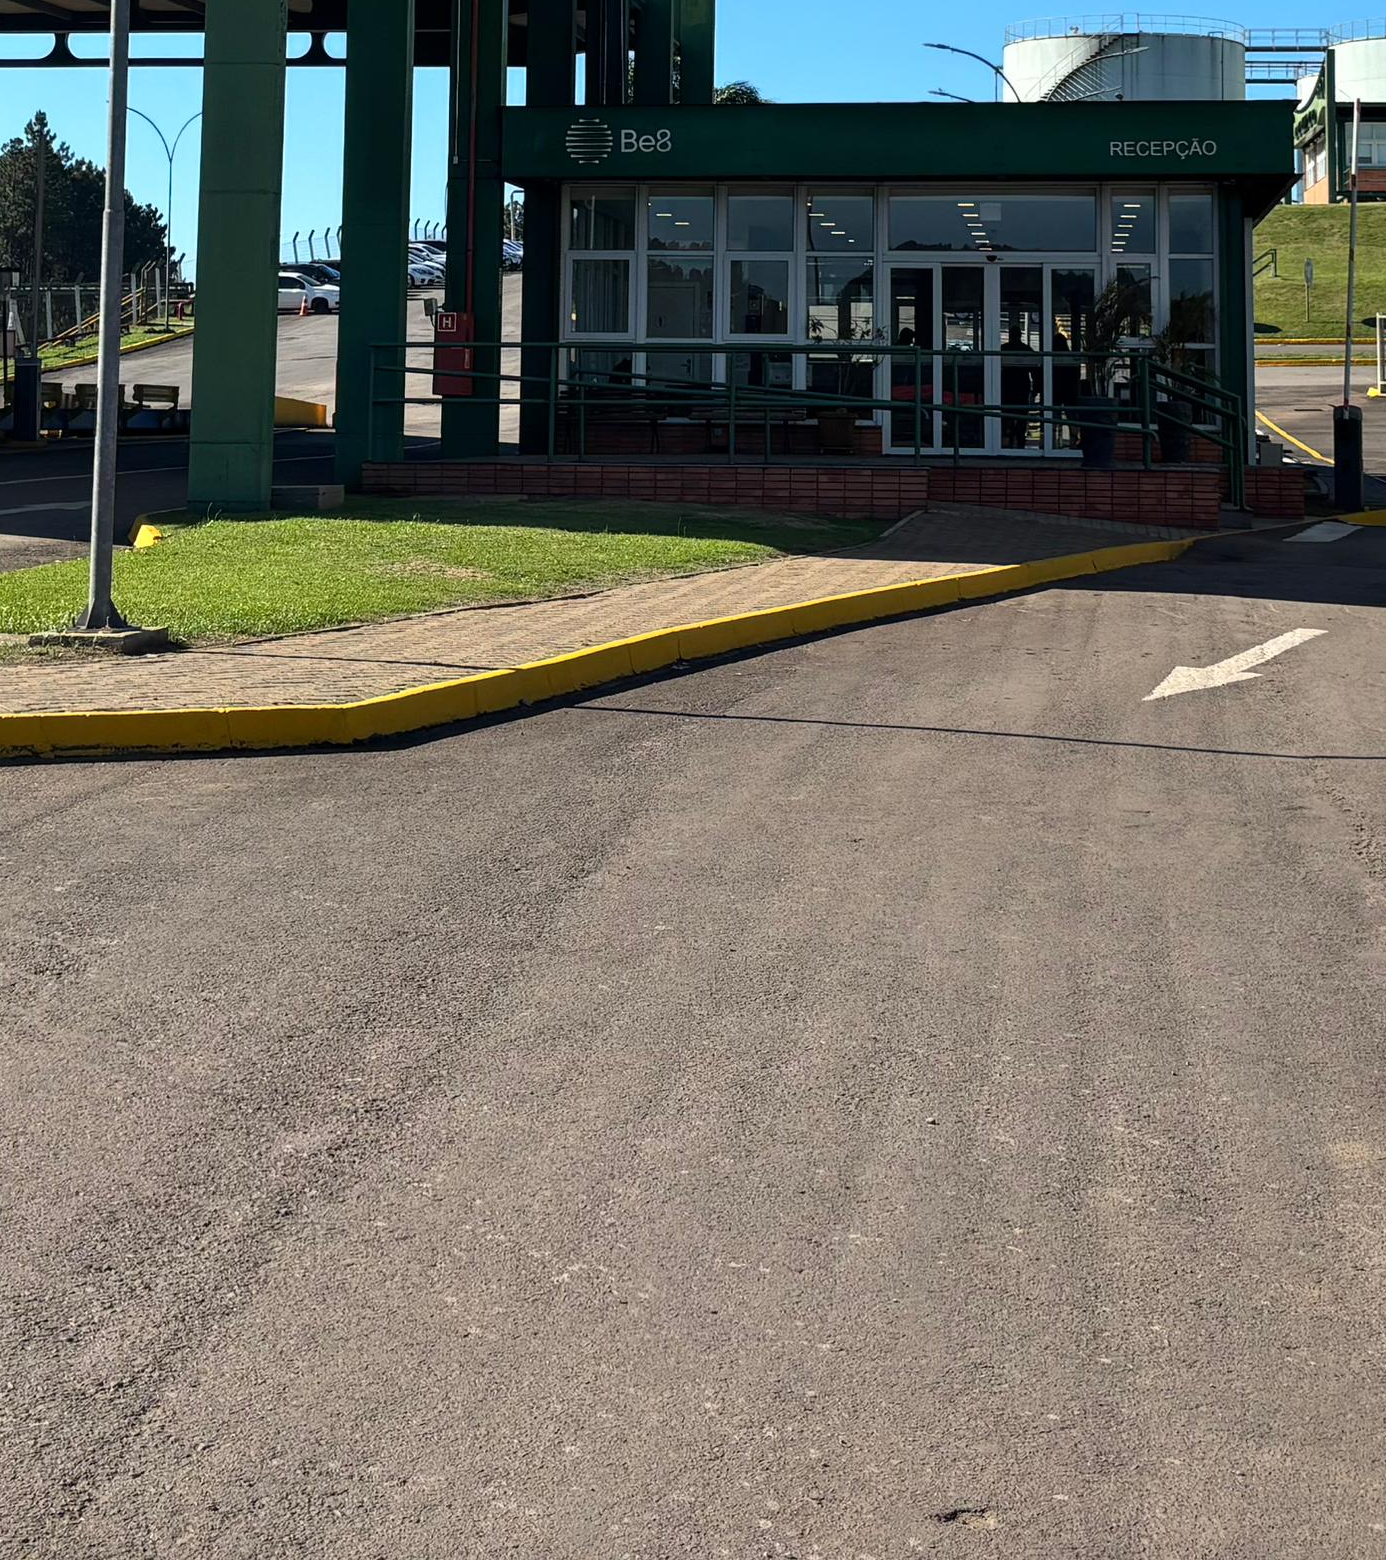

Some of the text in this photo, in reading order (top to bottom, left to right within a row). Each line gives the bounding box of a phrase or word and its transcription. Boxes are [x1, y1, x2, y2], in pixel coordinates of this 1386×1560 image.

[620, 128, 672, 153] Be8
[1109, 138, 1217, 160] RECEPÇÃO
[442, 316, 452, 329] H
